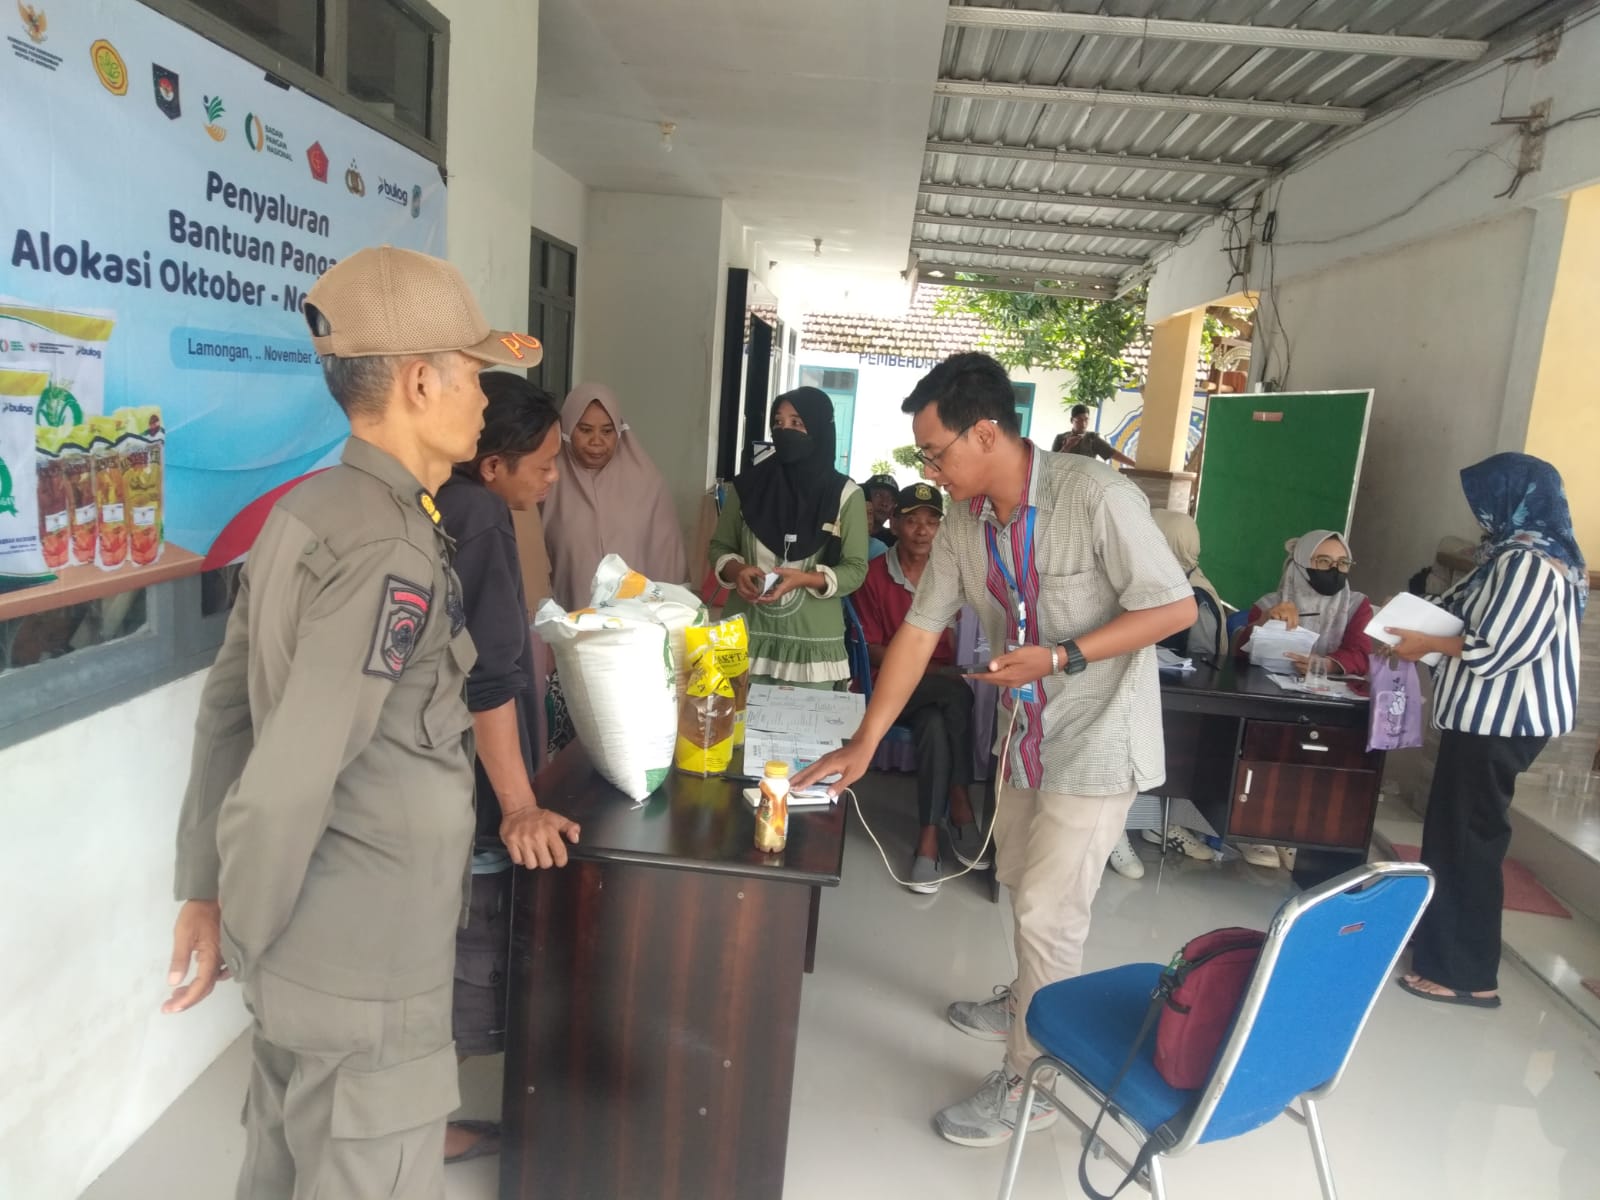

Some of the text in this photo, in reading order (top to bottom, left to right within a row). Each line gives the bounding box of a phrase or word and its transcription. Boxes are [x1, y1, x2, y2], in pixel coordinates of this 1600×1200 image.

[206, 170, 330, 238] Penyaluran
[169, 209, 275, 266] Bantuan
[11, 228, 152, 289] Alokasi
[159, 258, 266, 307] Oktober
[188, 338, 252, 362] Lamongan,
[264, 345, 313, 364] November
[858, 351, 942, 370] PEMBERDA
